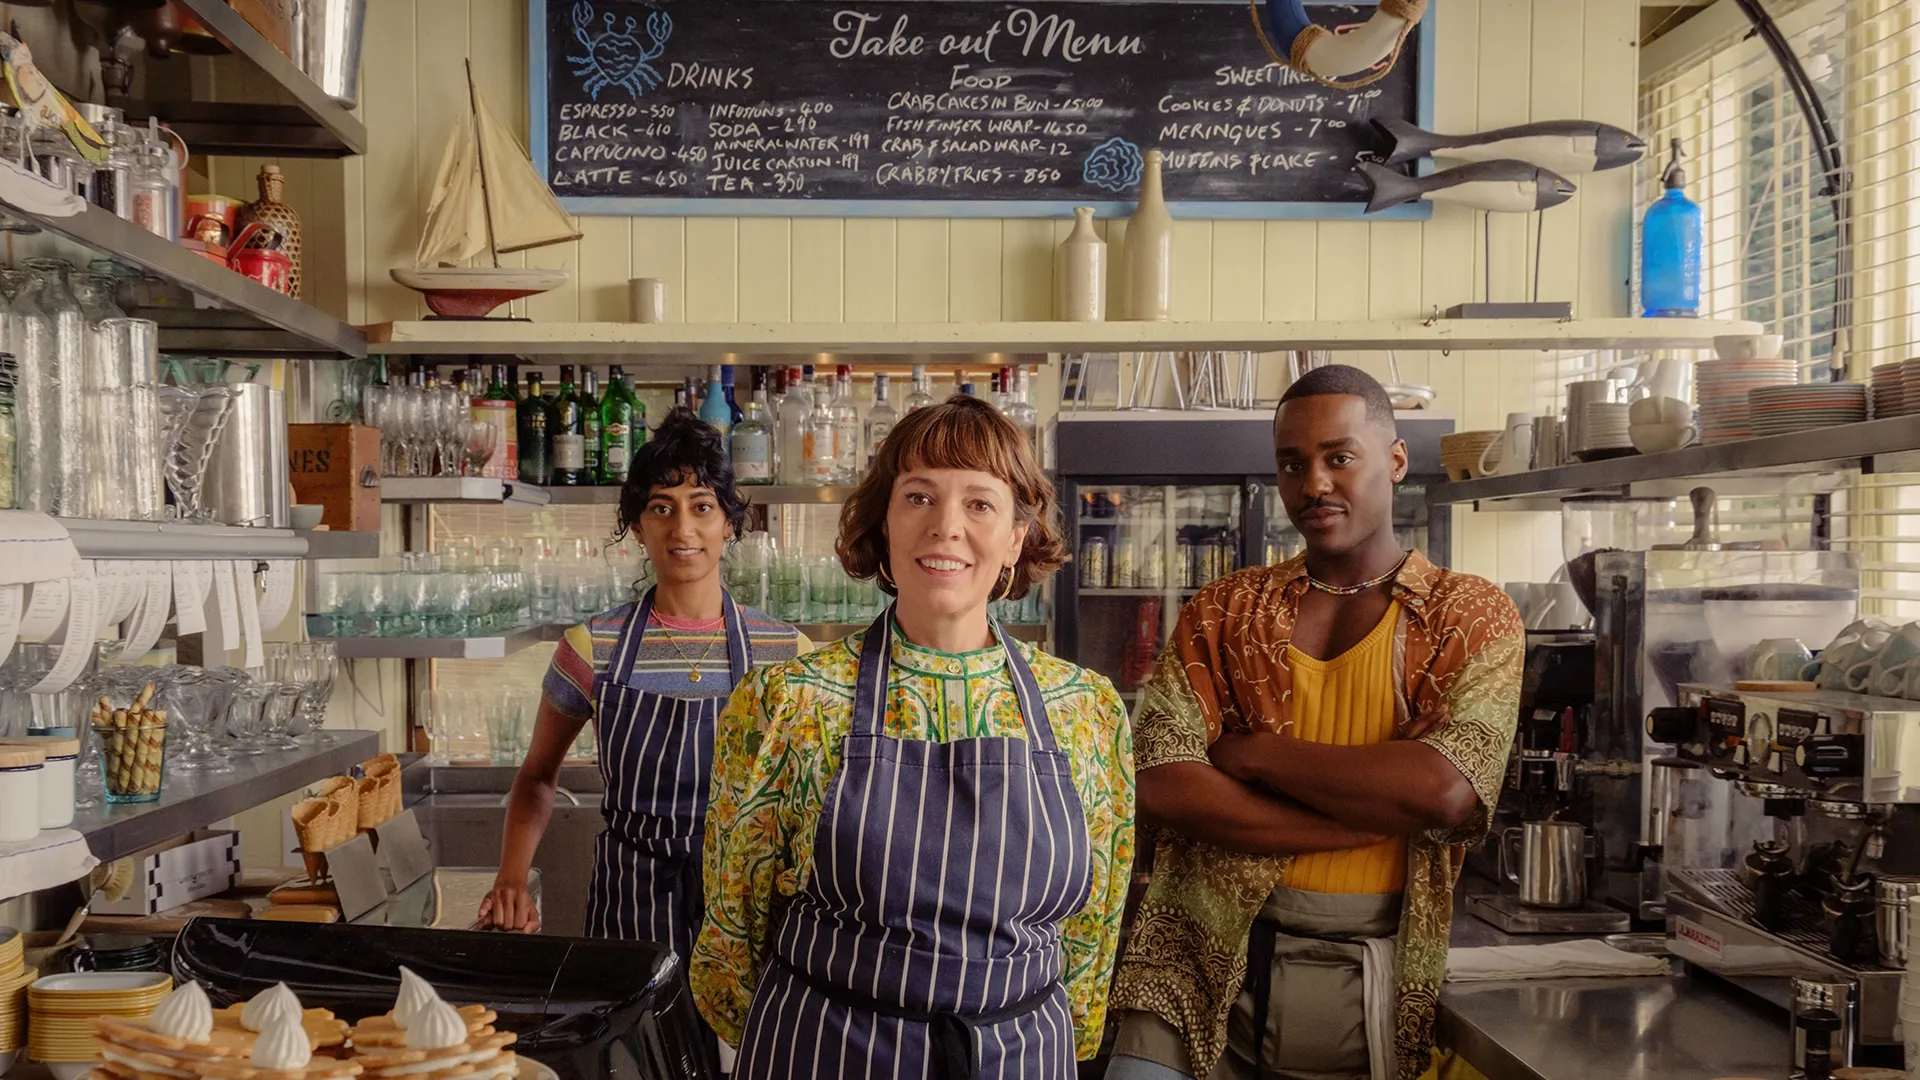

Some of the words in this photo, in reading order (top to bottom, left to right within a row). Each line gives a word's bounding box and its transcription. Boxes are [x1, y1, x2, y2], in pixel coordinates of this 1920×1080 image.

[829, 10, 924, 59] Take
[938, 20, 1002, 63] out
[1006, 8, 1144, 62] Menu
[667, 62, 754, 90] DRINKS
[949, 64, 1012, 90] FOOD
[1215, 62, 1280, 87] SWEET
[560, 103, 637, 121] ESPRESSO
[1014, 94, 1050, 112] BUN
[1158, 94, 1233, 114] COOKIES
[1257, 94, 1326, 114] DONUTS
[558, 124, 629, 142] BLACK
[708, 122, 762, 138] SODA
[887, 115, 924, 133] FISH
[926, 119, 983, 137] FINGER
[988, 118, 1034, 134] WRAP
[1159, 121, 1283, 146] MERINGUES
[555, 144, 667, 163] CAPPUCINO
[881, 136, 925, 160] CRAB
[941, 139, 992, 154] SALAD
[993, 139, 1041, 155] WRAP
[711, 153, 761, 172] JUICE
[1261, 152, 1321, 171] CAKE
[553, 166, 632, 186] LATTE
[706, 174, 754, 193] TEA
[954, 165, 1003, 185] FRIES
